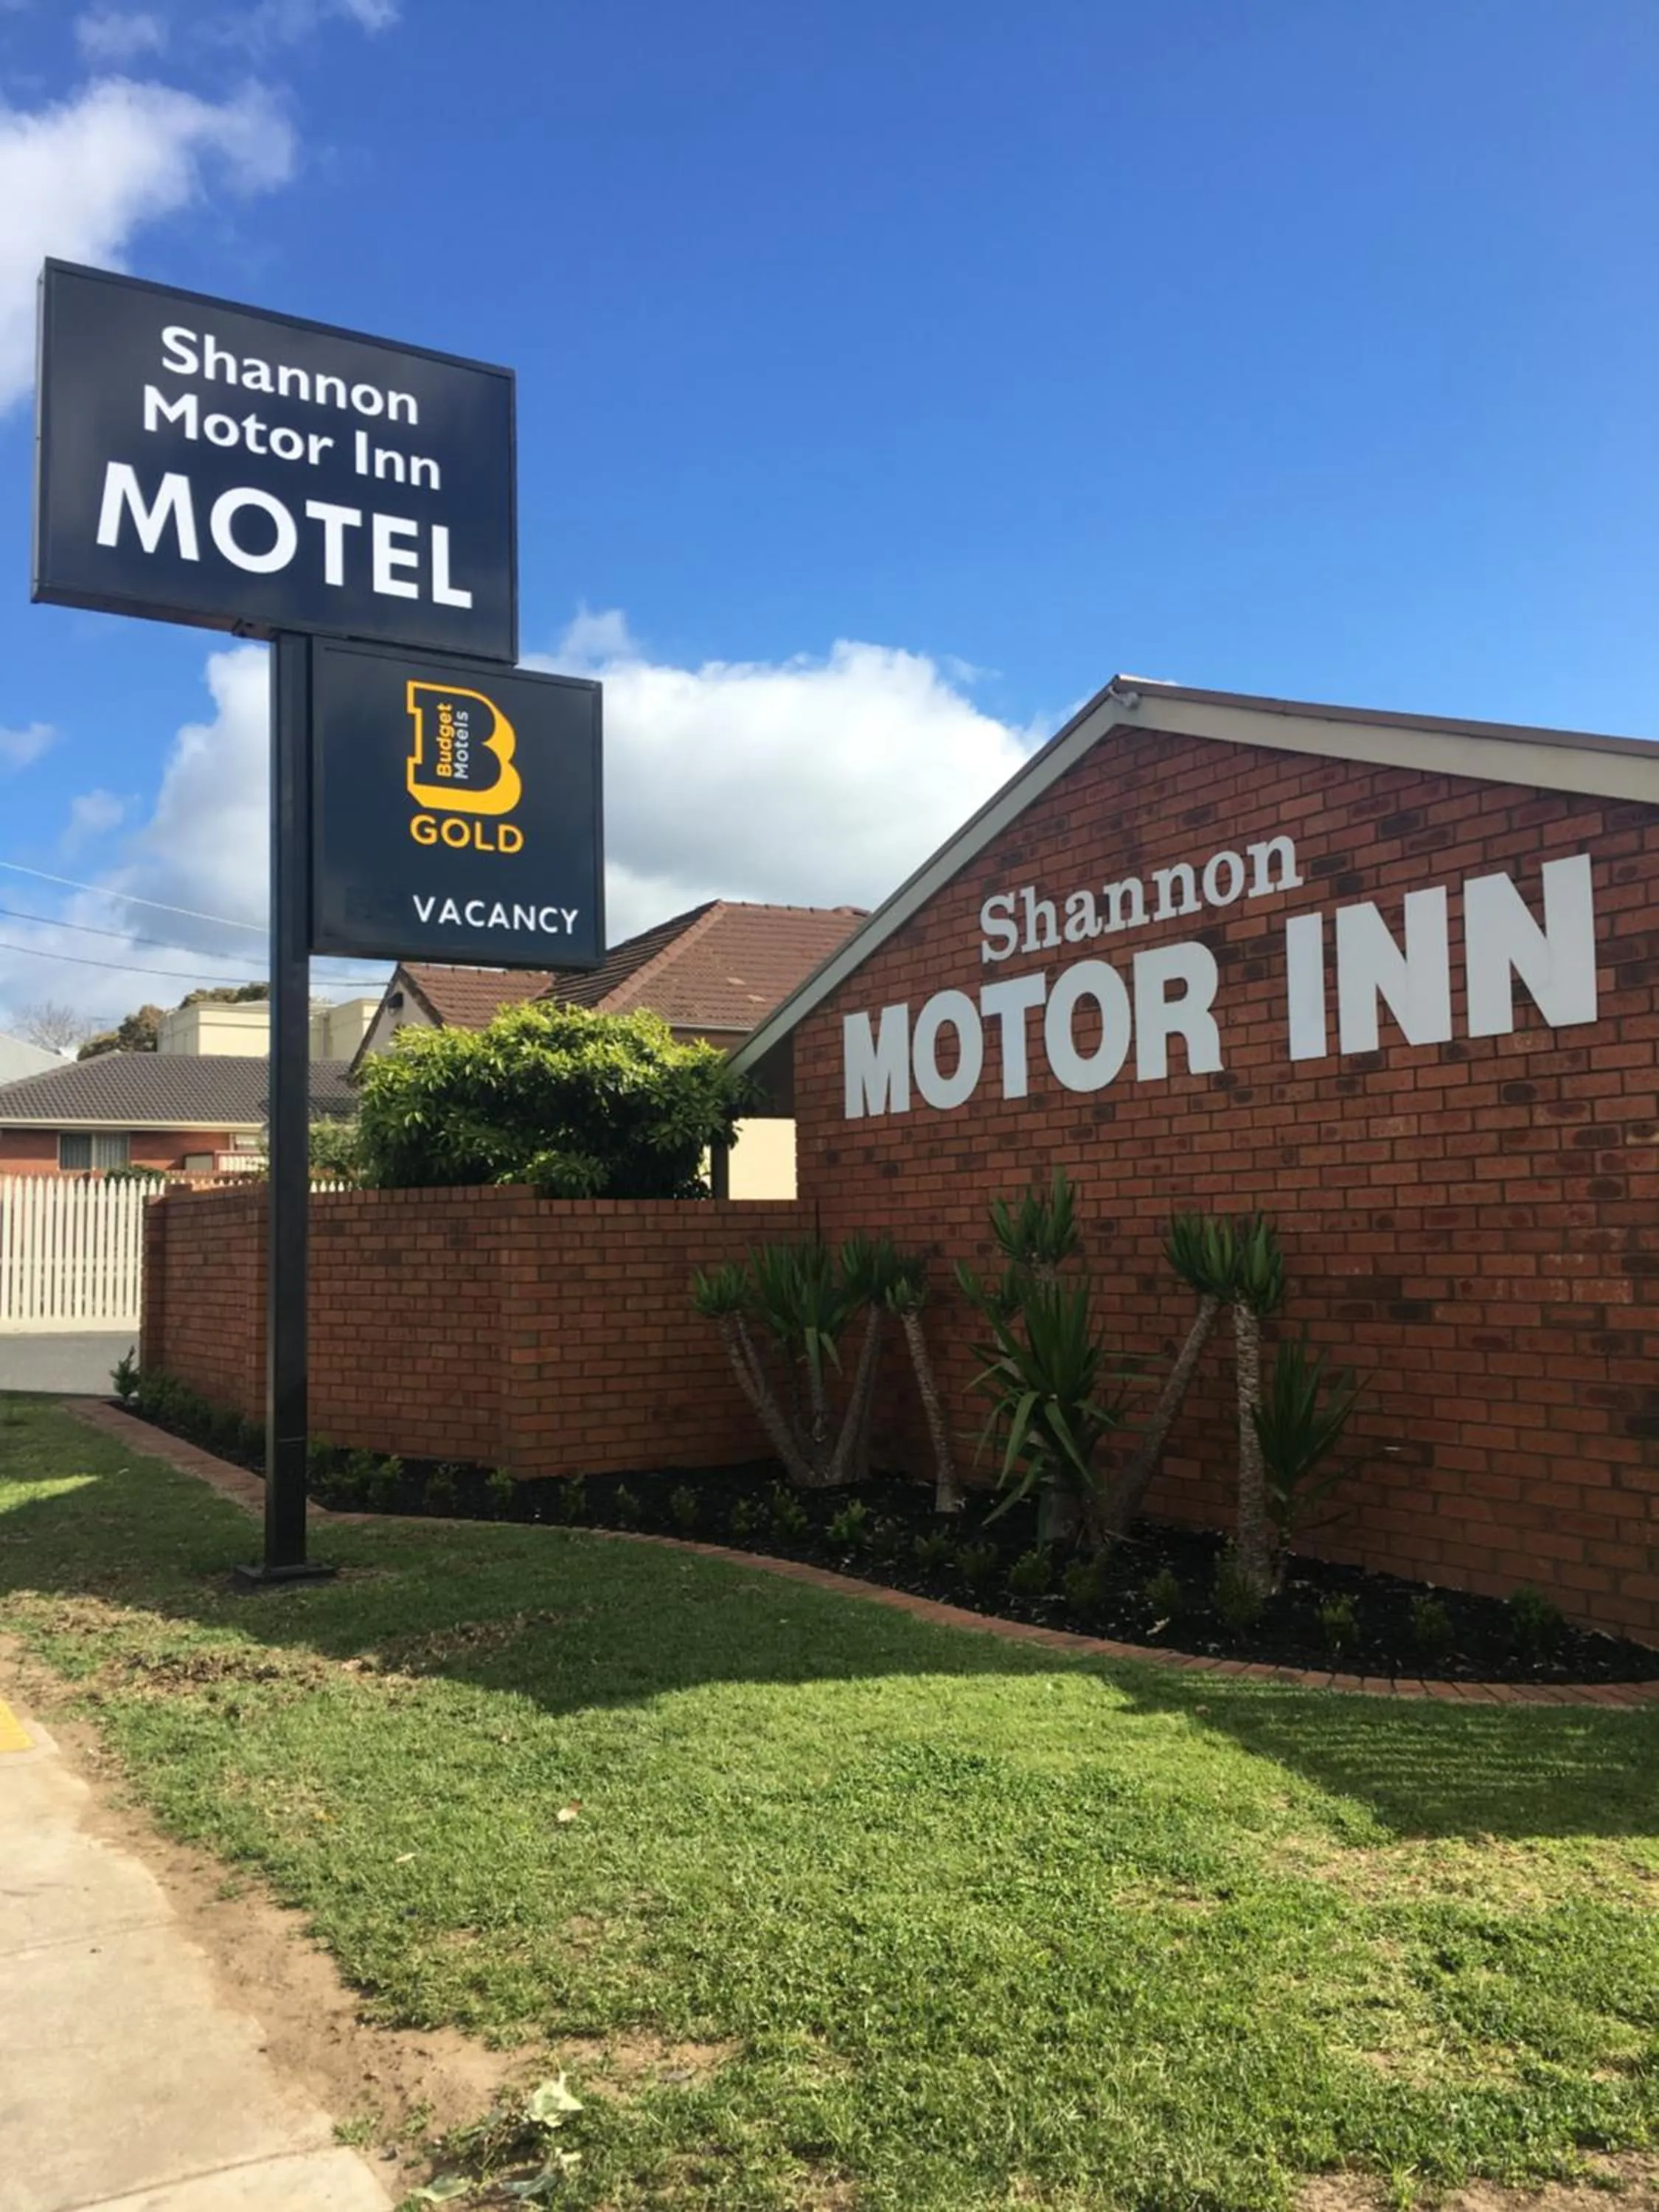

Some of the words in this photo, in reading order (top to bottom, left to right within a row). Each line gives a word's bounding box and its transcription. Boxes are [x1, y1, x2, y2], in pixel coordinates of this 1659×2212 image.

[161, 326, 418, 424] Shannon
[144, 385, 333, 465] Motor
[355, 429, 441, 490] Inn
[97, 461, 473, 609] MOTEL
[407, 680, 522, 815] B
[436, 703, 454, 777] Budget
[453, 710, 469, 779] Motels
[409, 814, 524, 854] GOLD
[412, 894, 579, 935] VACANCY
[979, 835, 1303, 964] Shannon
[844, 941, 1224, 1120] MOTOR
[1285, 853, 1598, 1061] INN
